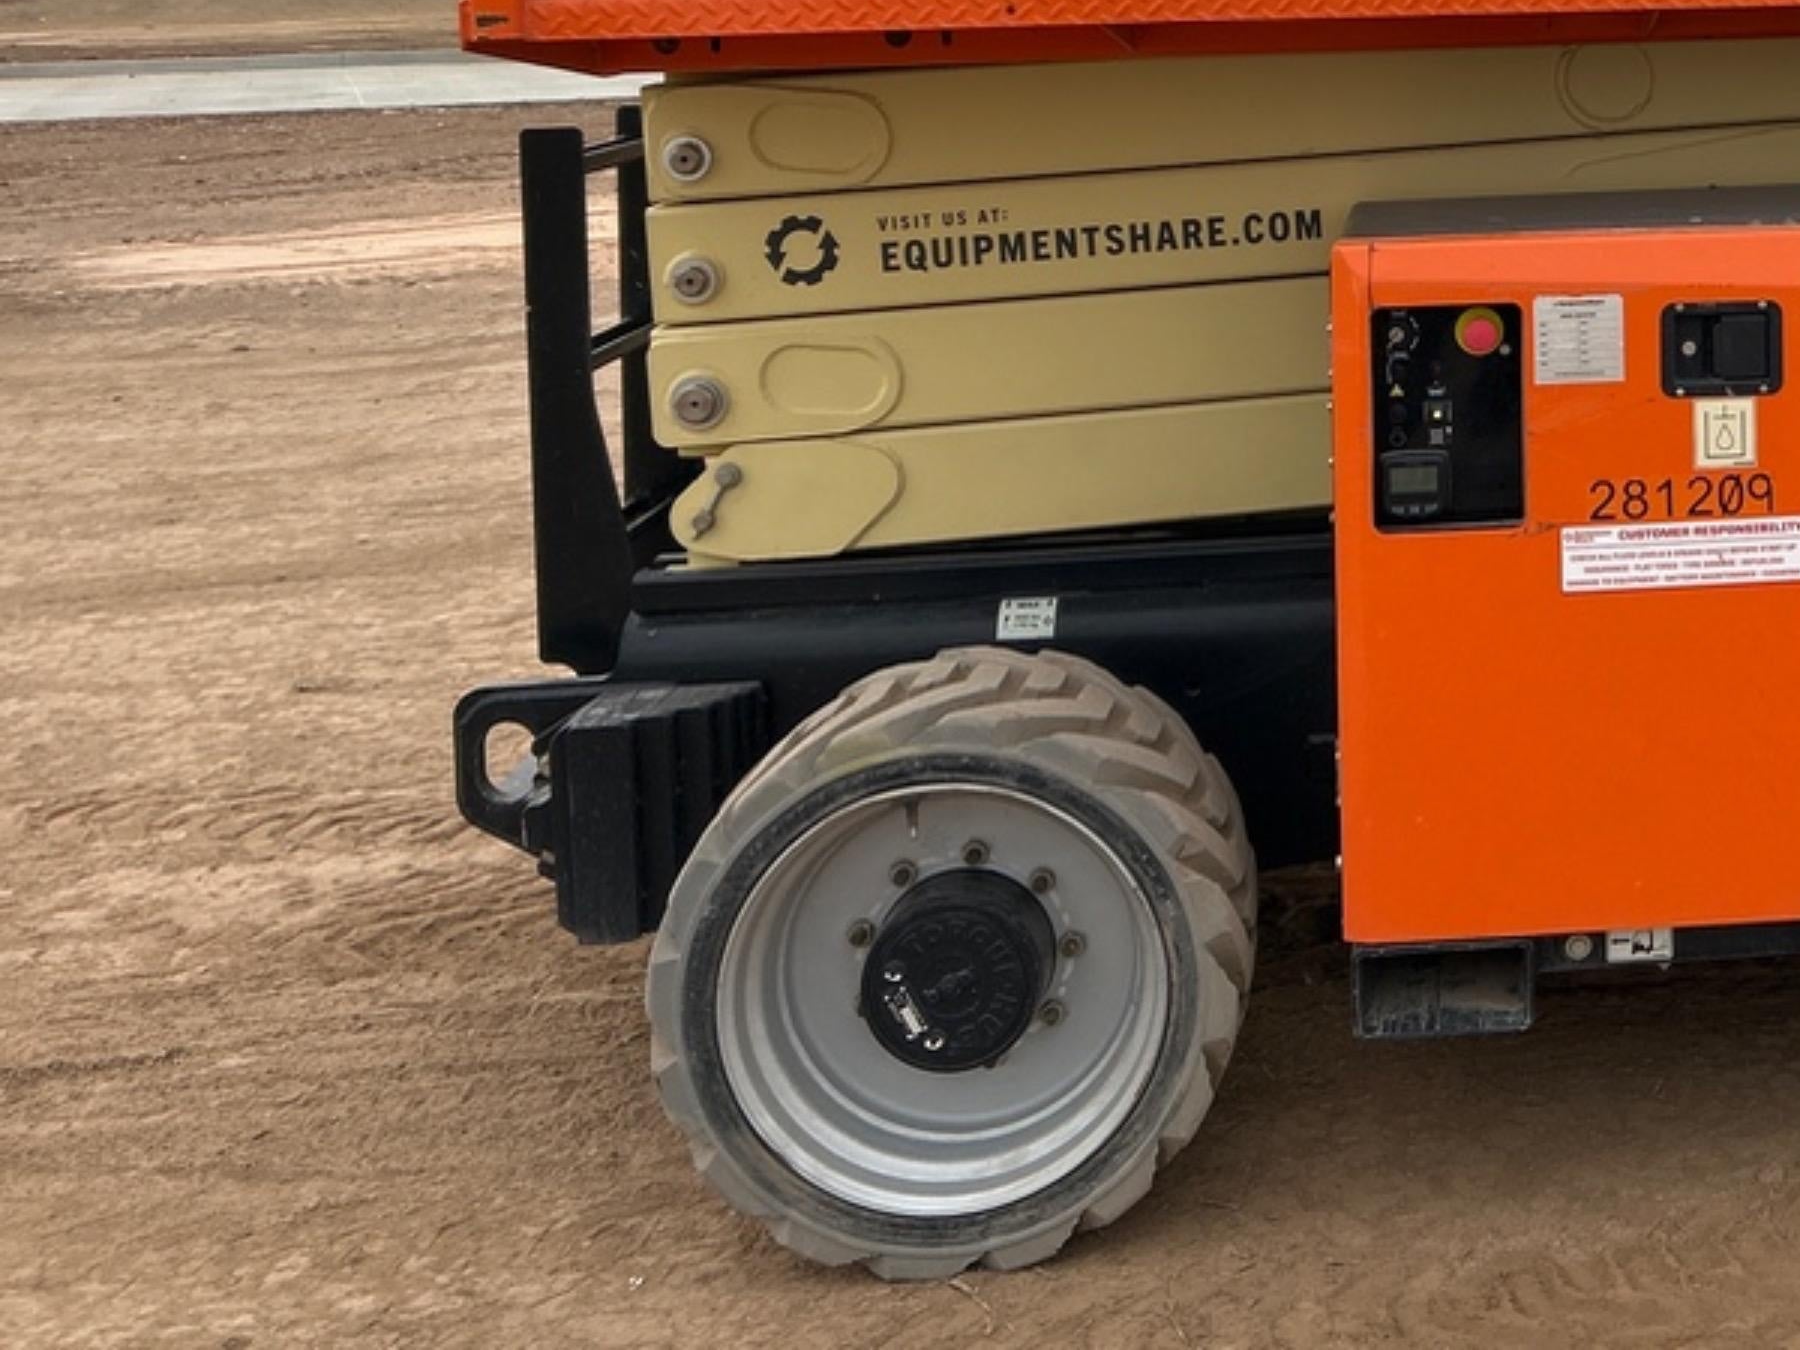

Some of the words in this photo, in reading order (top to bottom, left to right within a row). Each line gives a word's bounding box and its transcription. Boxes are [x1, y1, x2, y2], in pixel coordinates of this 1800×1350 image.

[876, 213, 932, 233] VISIT
[941, 211, 967, 227] US
[977, 207, 1010, 225] AT:
[879, 208, 1324, 274] EQUIPMENTSHARE.COM
[1590, 473, 1775, 521] 281209
[1617, 526, 1690, 542] CUSTOMER
